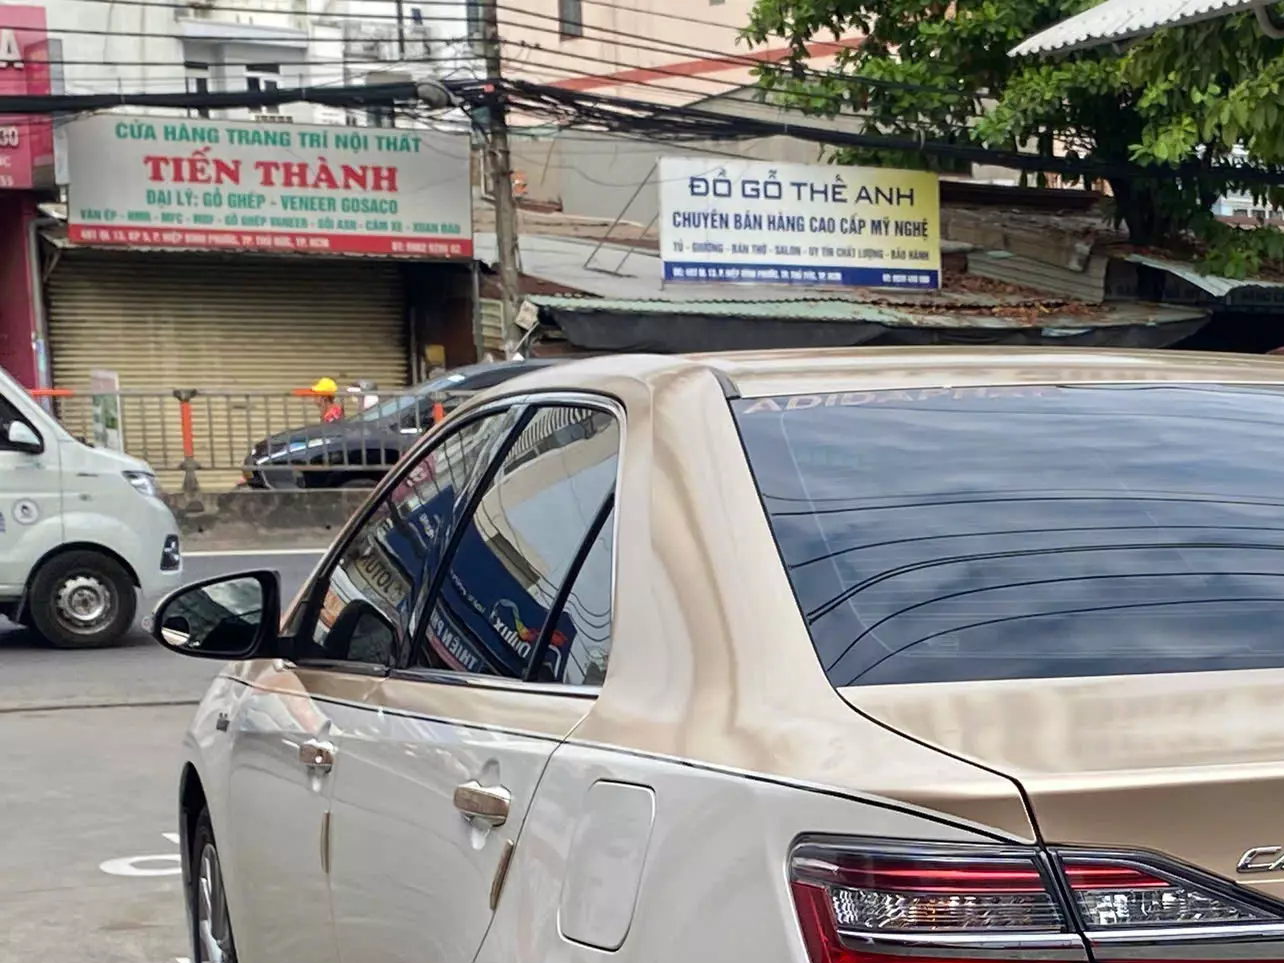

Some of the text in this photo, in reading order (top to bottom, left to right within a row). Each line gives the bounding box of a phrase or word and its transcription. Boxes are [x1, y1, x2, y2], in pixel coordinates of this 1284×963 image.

[115, 119, 157, 141] CỬA
[163, 123, 220, 144] HÀNG
[225, 127, 291, 147] TRANG
[335, 132, 368, 154] NỘI
[374, 133, 422, 153] THẤT
[143, 146, 399, 193] TIẾN THÀNH
[280, 195, 337, 212] VENEER
[341, 197, 398, 215] GOSACO
[741, 169, 783, 200] GỖ
[854, 185, 915, 207] ANH
[672, 209, 729, 229] CHUYÊN
[733, 210, 762, 231] BÁN
[767, 212, 805, 233] HÀNG
[809, 216, 836, 233] CAO
[840, 213, 866, 235] CẤP
[894, 218, 929, 241] NGHỆ
